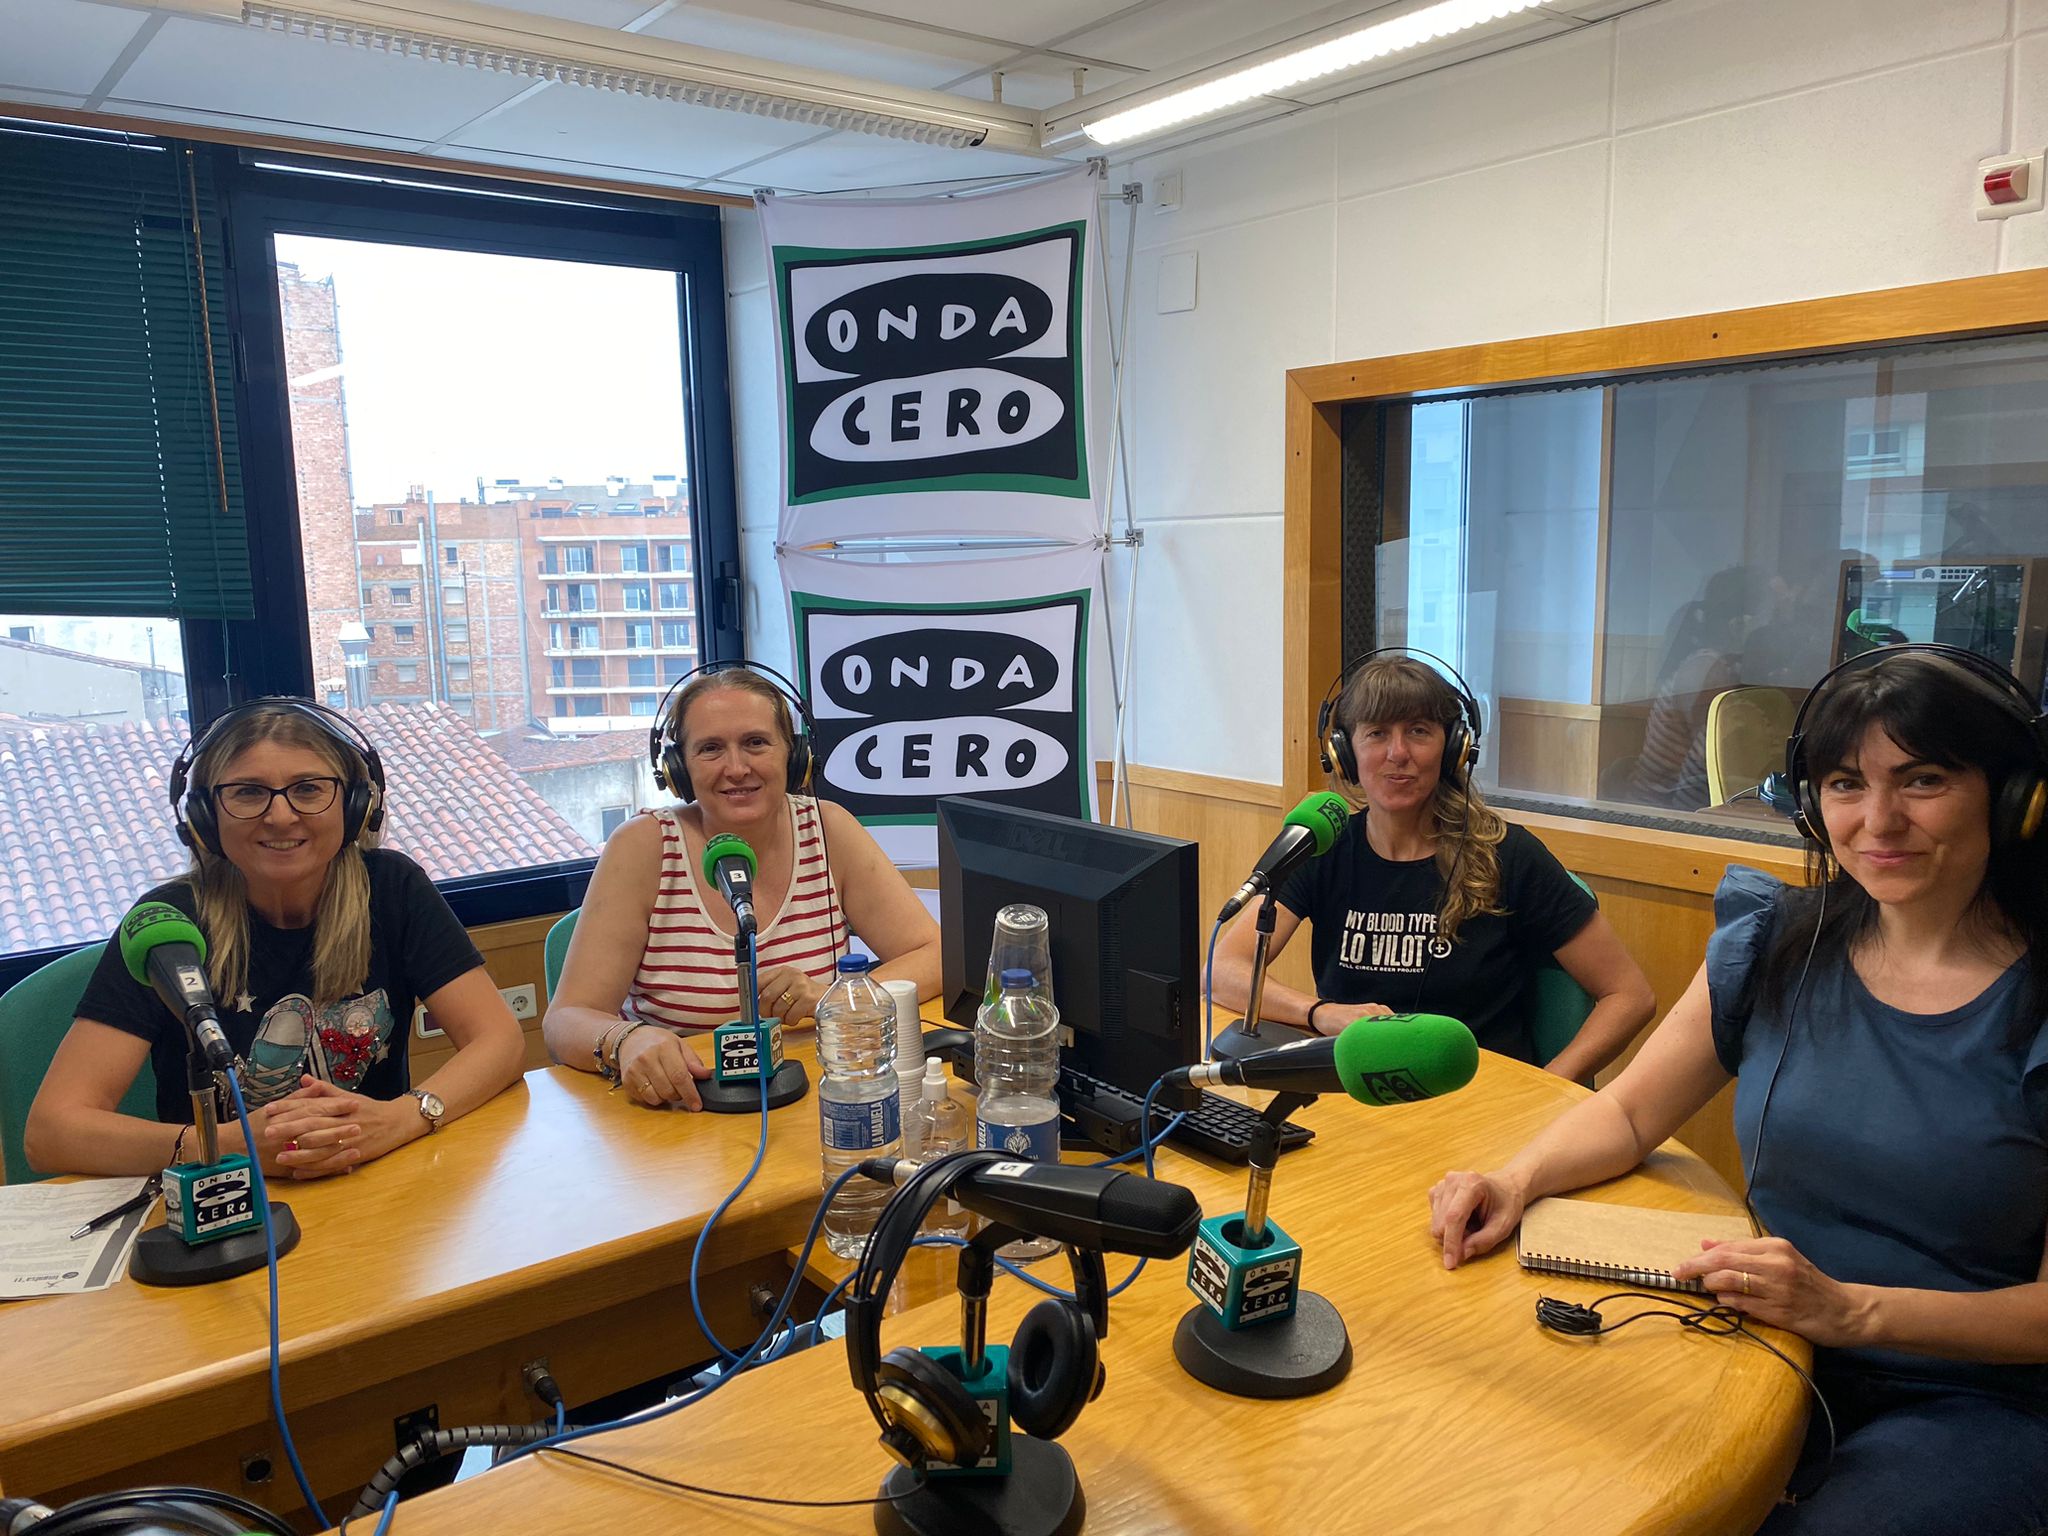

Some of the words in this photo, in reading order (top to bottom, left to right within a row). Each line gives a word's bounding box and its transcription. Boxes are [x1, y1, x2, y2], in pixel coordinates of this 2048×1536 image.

[827, 296, 1027, 353] ONDA
[842, 387, 1031, 446] CERO
[842, 654, 1034, 695] ONDA
[855, 733, 1037, 780] CERO
[1345, 909, 1366, 930] MY
[1366, 912, 1404, 932] BLOOD
[1408, 913, 1437, 933] TYPE
[1339, 930, 1366, 964] LO
[1371, 934, 1427, 967] VILOT
[1338, 962, 1354, 970] FULL
[185, 976, 197, 987] 2
[722, 1057, 759, 1068] CERO
[870, 1101, 884, 1137] MAJUELA
[871, 1136, 885, 1148] LA
[198, 1170, 245, 1188] ONDA
[999, 1164, 1018, 1173] 5
[197, 1201, 247, 1222] CERO
[1199, 1239, 1227, 1271] ONDA
[1249, 1261, 1291, 1278] ONDA
[1192, 1267, 1223, 1303] CERO
[1242, 1292, 1286, 1312] CERO
